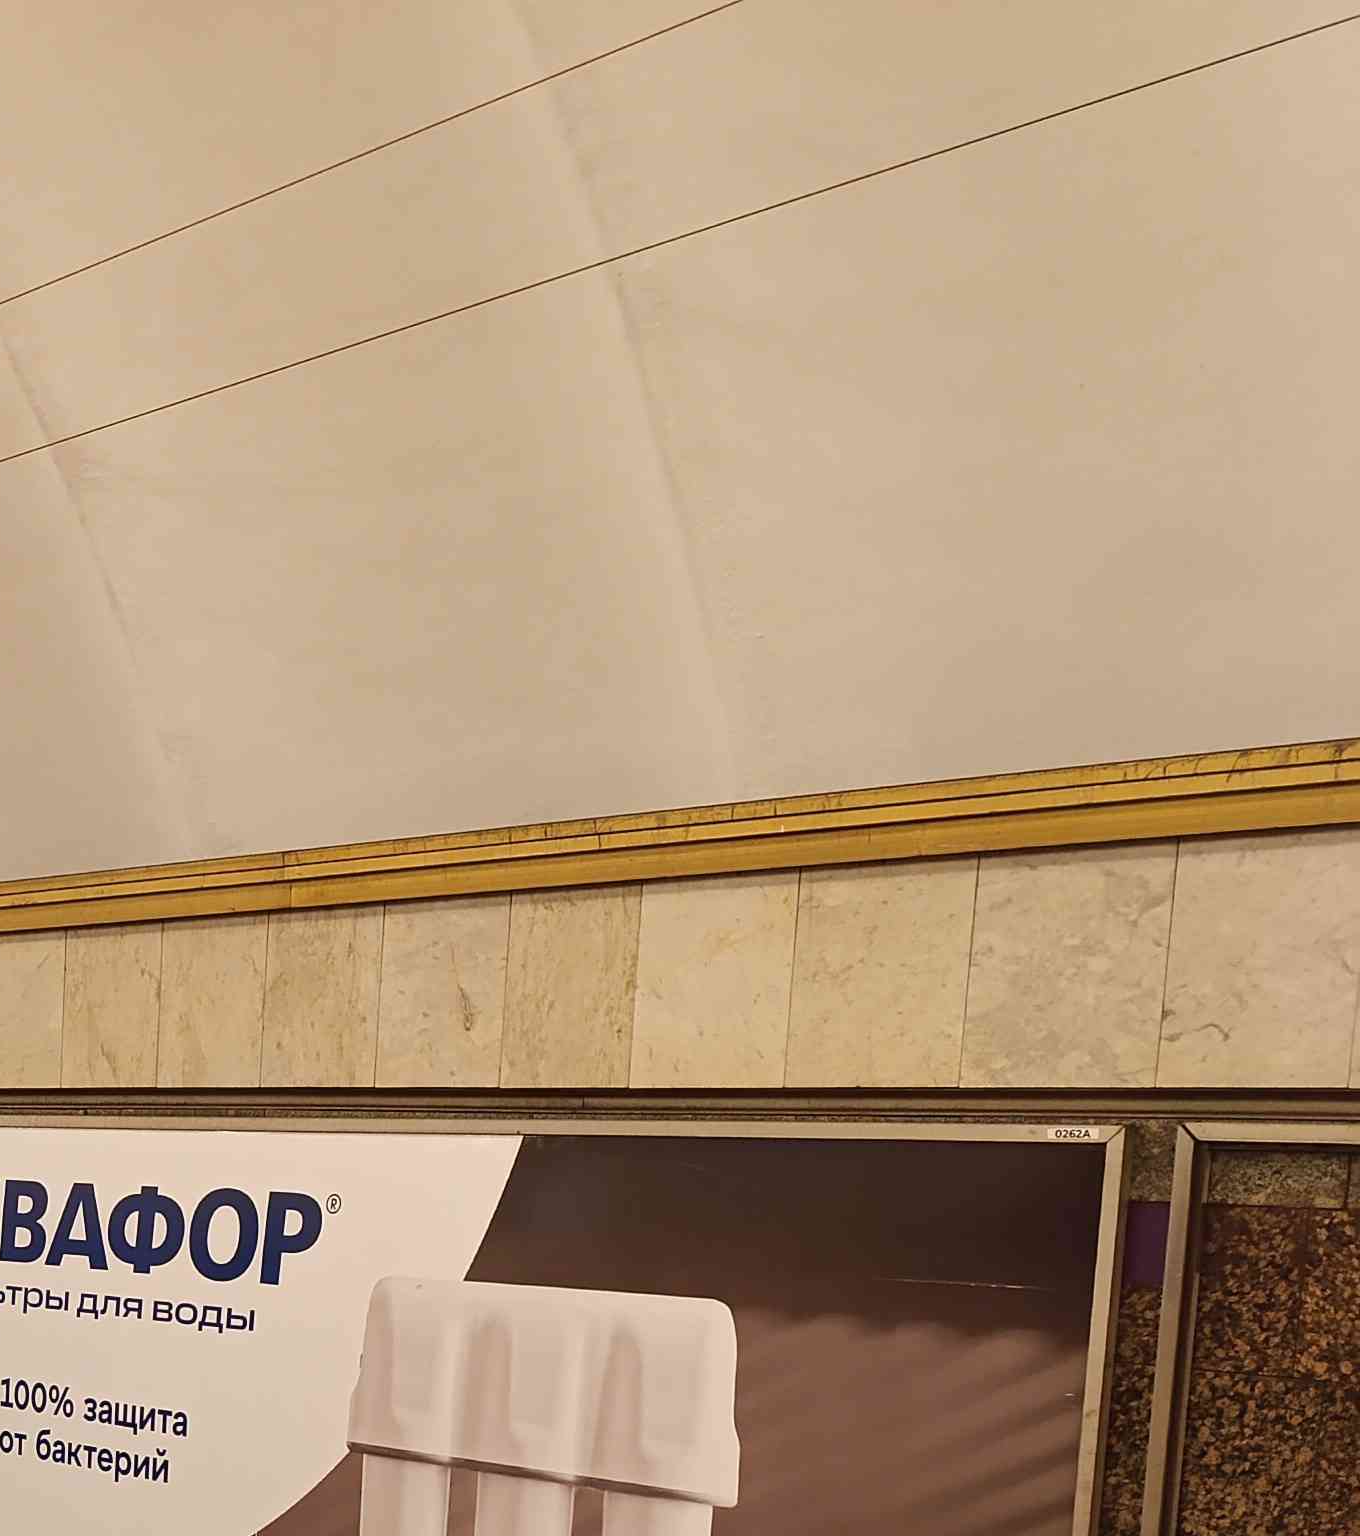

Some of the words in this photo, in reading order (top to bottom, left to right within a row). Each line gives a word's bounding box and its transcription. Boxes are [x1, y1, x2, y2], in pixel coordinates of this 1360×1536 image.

[76, 1292, 143, 1320] для
[153, 1299, 257, 1333] воды
[0, 1376, 75, 1418] 100%
[84, 1394, 189, 1437] защита
[0, 1429, 27, 1456] от
[36, 1428, 170, 1483] бактерий
